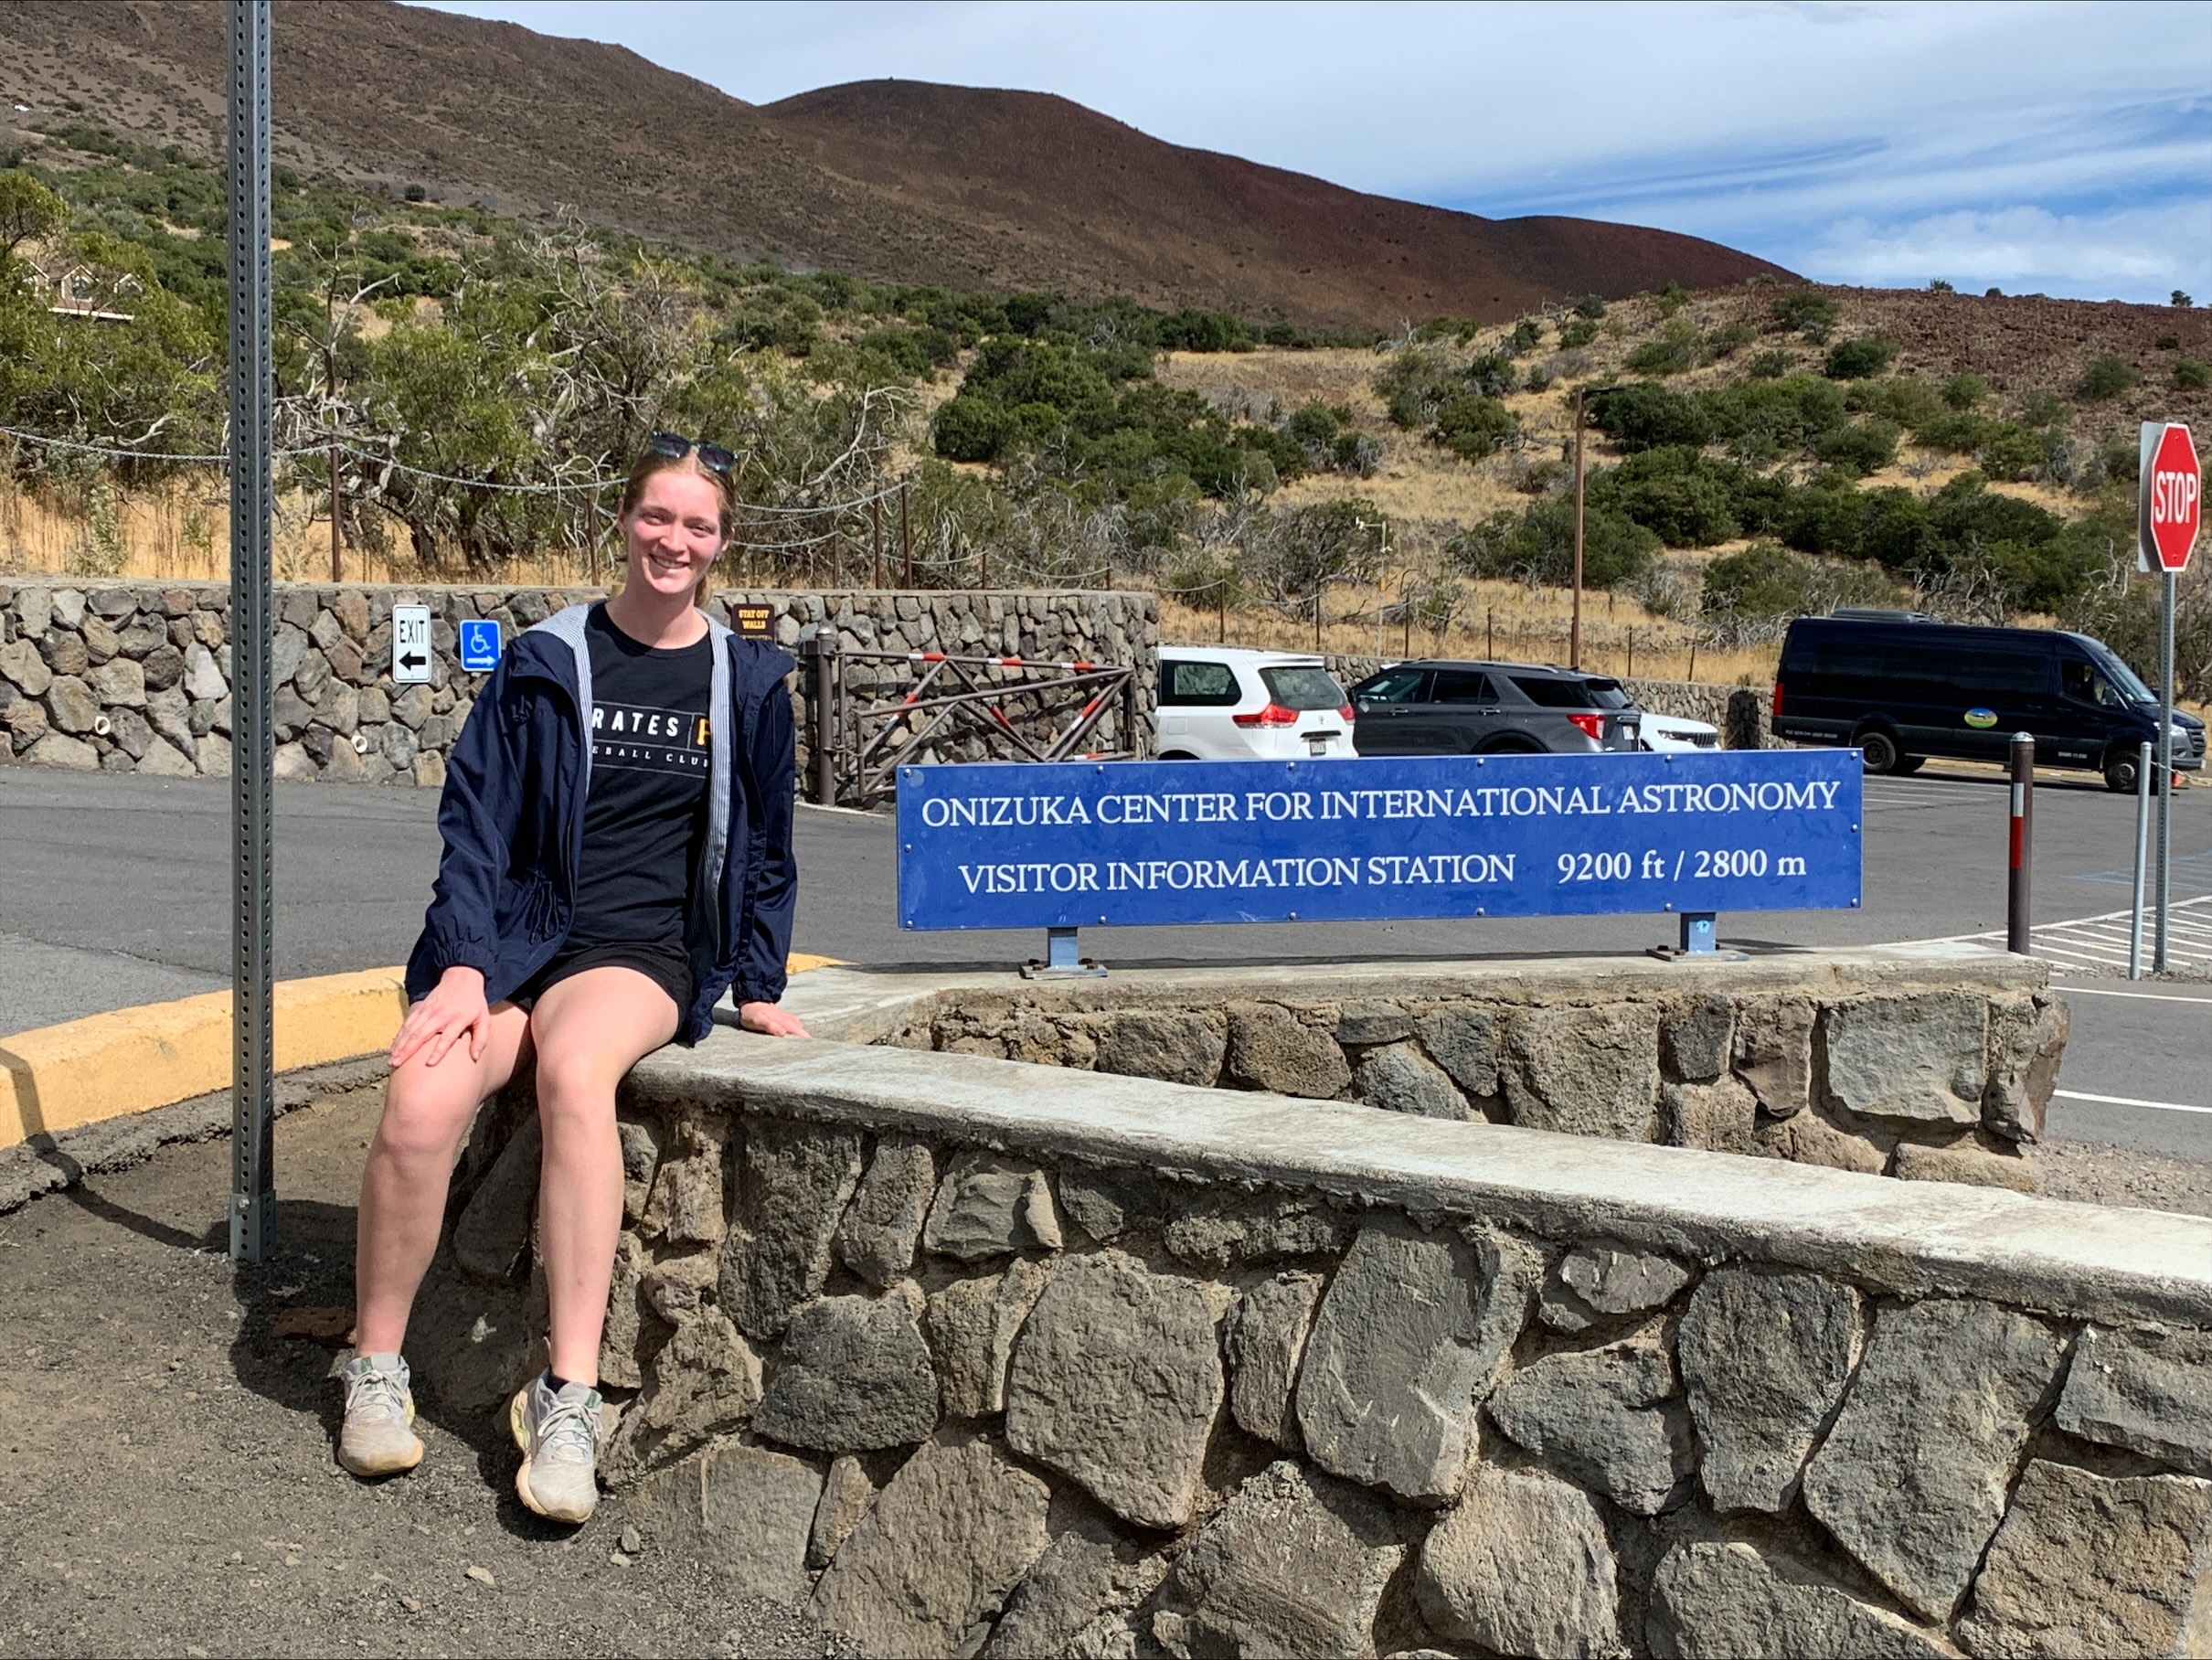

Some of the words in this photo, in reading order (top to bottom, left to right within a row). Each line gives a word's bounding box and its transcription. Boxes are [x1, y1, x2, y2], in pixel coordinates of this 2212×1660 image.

[2154, 470, 2197, 524] STOP
[739, 609, 756, 619] STAY
[756, 609, 770, 619] OFF
[742, 620, 766, 630] WALLS
[399, 620, 425, 644] EXIT
[591, 708, 680, 738] RATES
[921, 796, 1092, 827] ONIZUKA
[1096, 793, 1239, 824] CENTER
[1245, 792, 1314, 821] FOR
[1320, 786, 1611, 820] INTERNATIONAL
[1616, 781, 1842, 814] ASTRONOMY
[958, 863, 1101, 894] VISITOR
[1106, 857, 1362, 891] INFORMATION
[1367, 854, 1516, 886] STATION
[1558, 852, 1632, 884] 9200
[1641, 849, 1666, 879] ft
[1674, 850, 1685, 881] /
[1694, 849, 1769, 878] 2800
[1776, 856, 1808, 877] m
